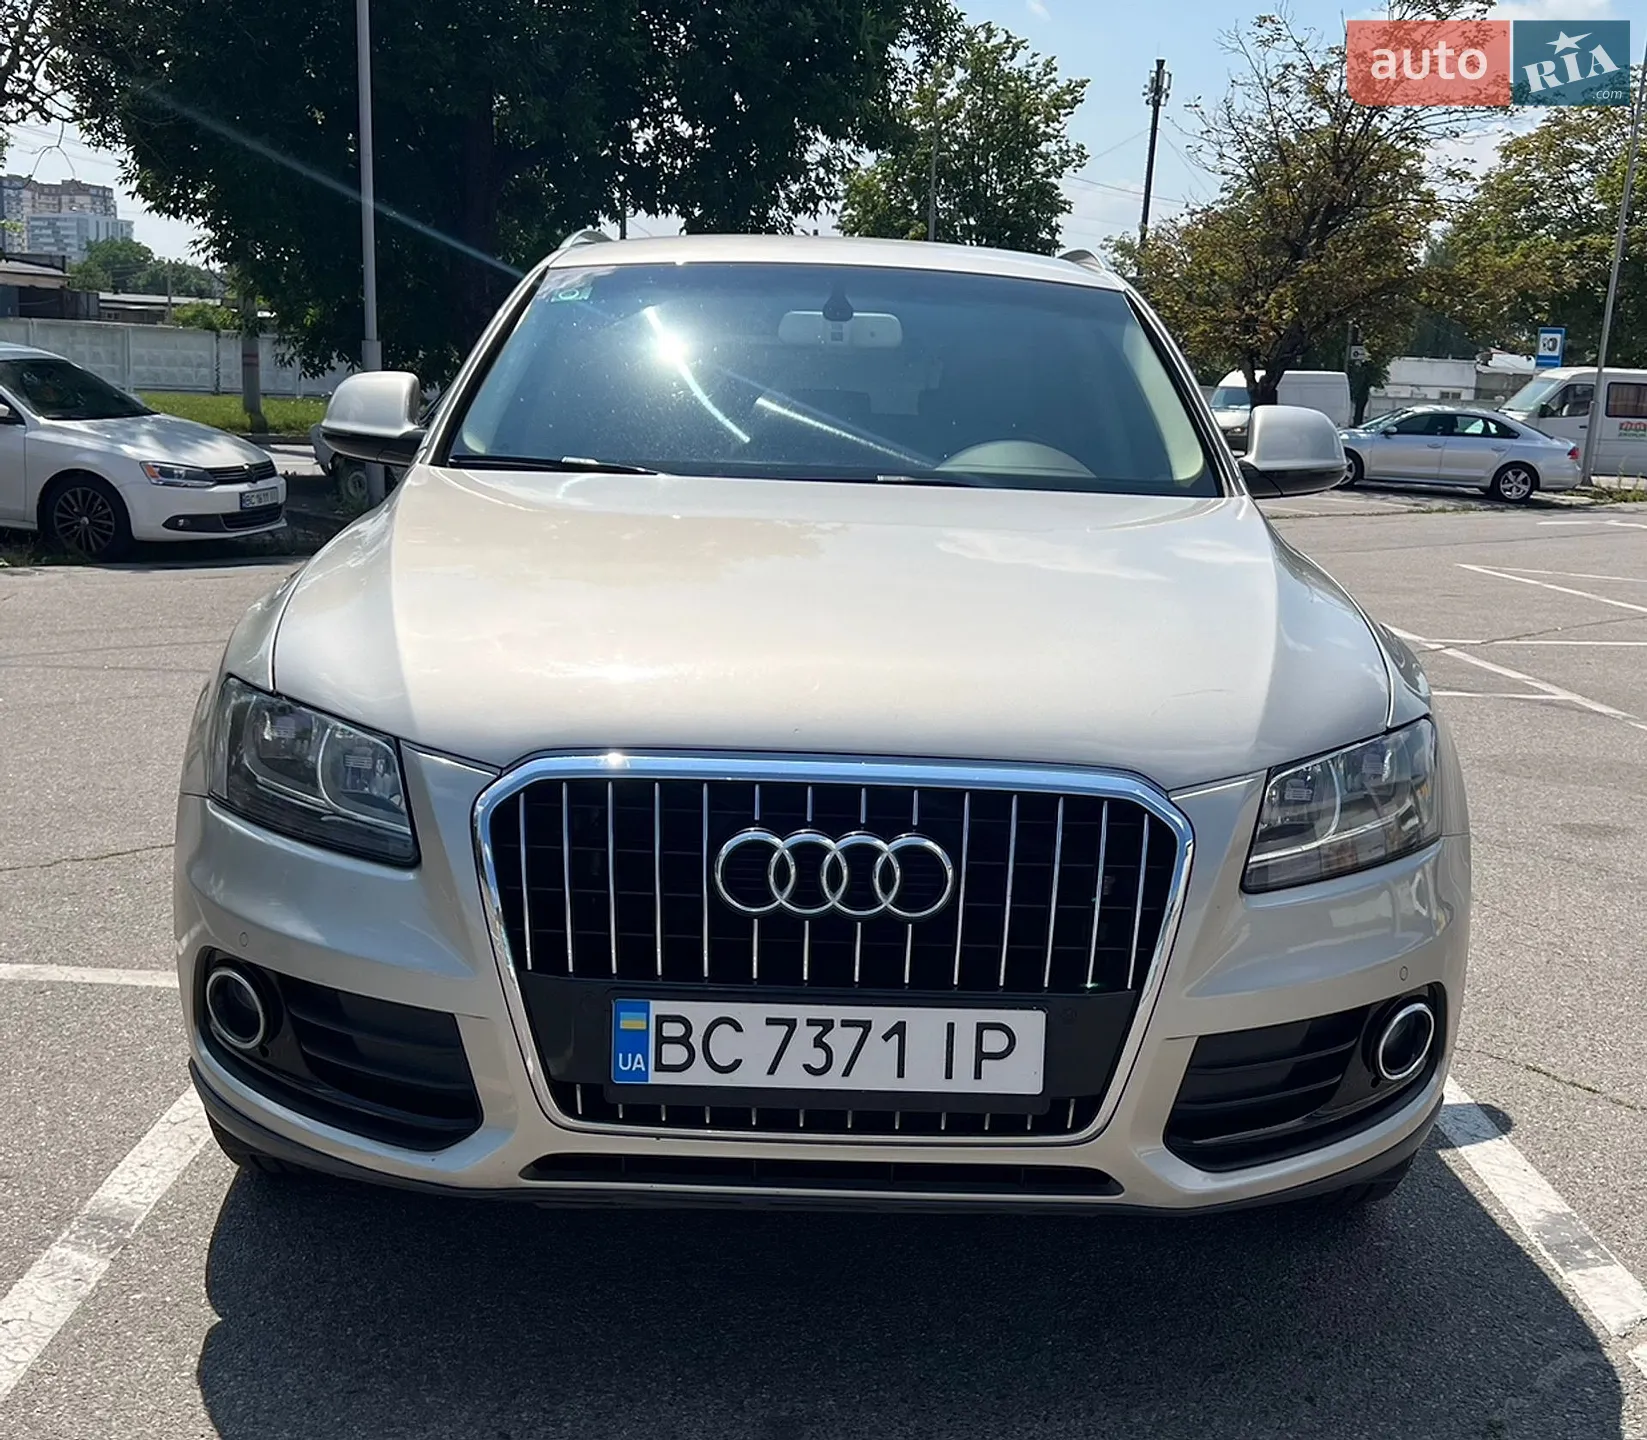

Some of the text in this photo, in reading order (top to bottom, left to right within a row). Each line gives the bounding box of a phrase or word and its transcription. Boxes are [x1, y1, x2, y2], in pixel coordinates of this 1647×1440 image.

[618, 1053, 646, 1072] UA
[653, 1014, 1017, 1081] BC 7371 IP
